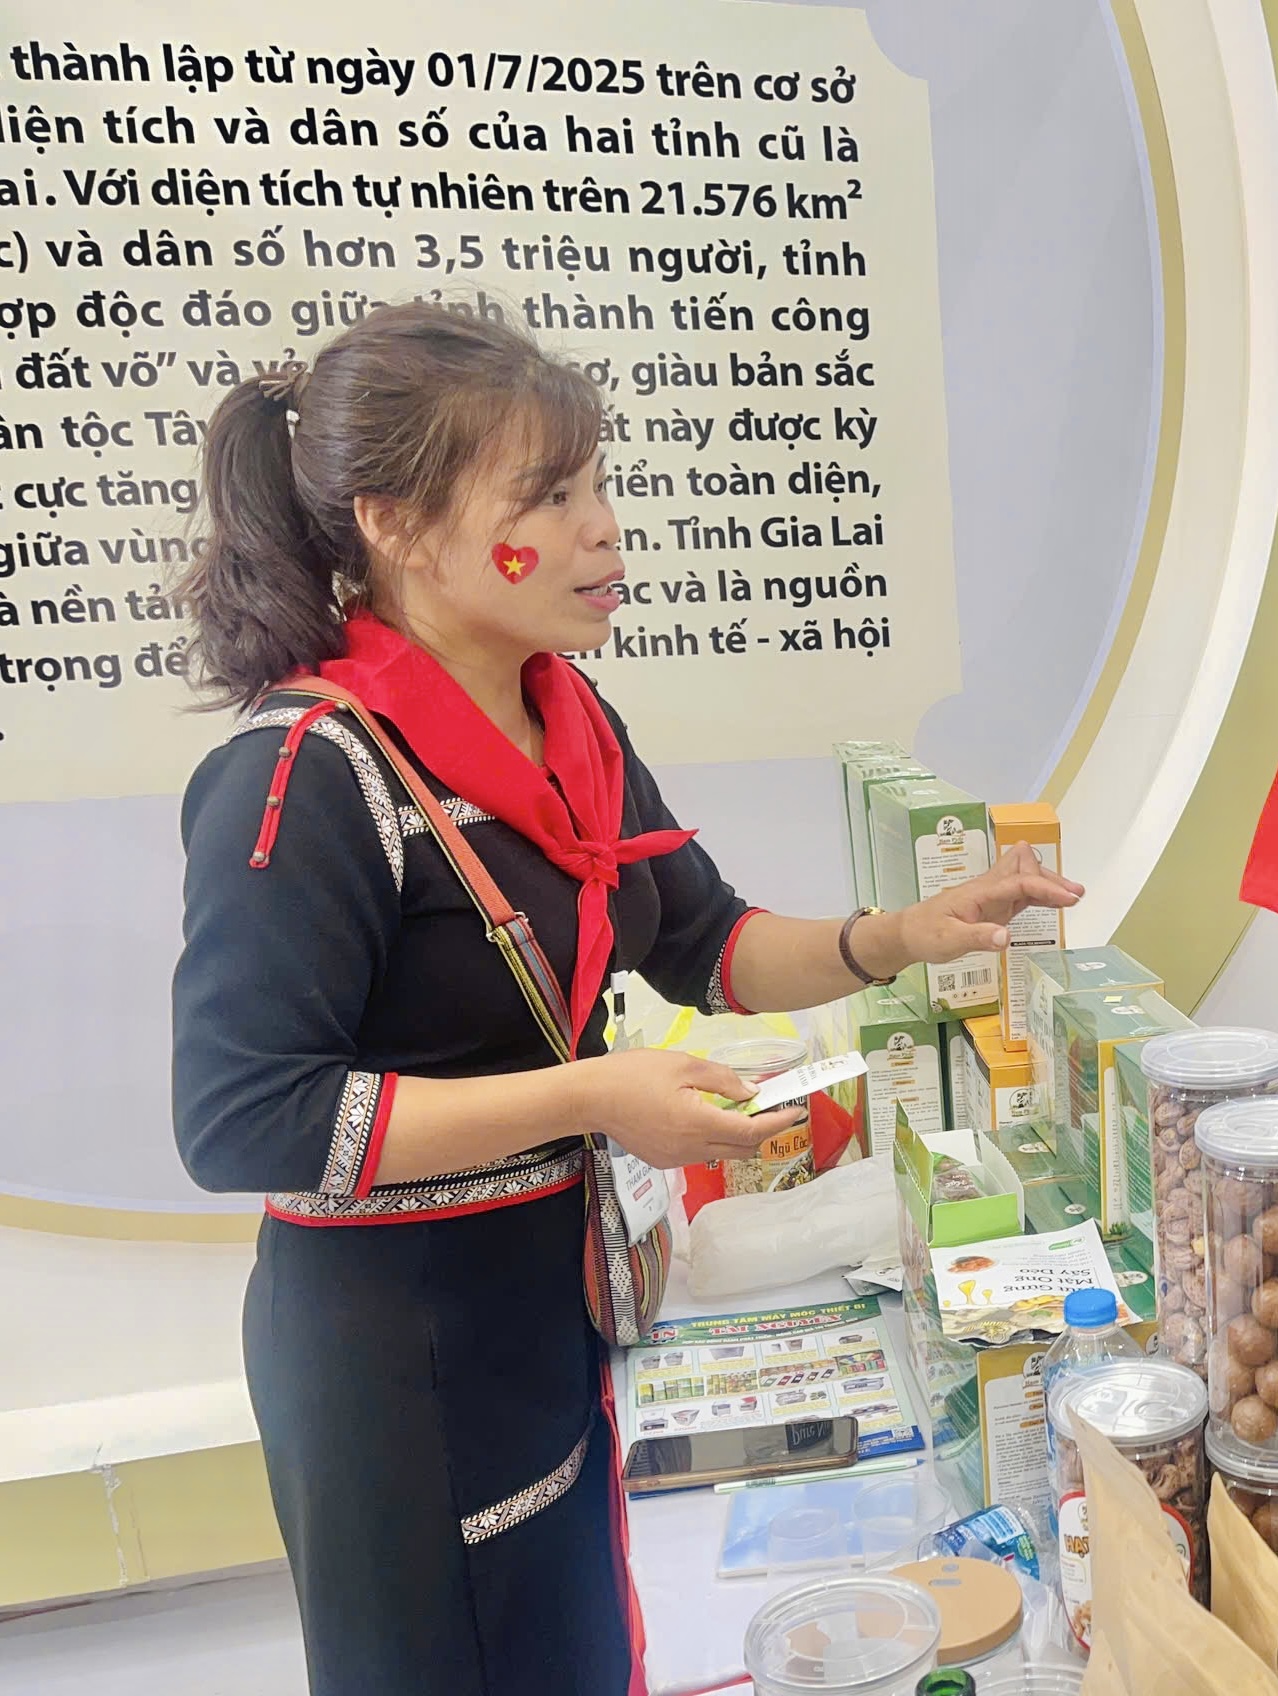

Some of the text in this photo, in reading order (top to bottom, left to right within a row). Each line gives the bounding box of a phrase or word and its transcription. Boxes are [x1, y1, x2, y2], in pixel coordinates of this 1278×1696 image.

[9, 41, 857, 104] thành lập từ ngày 01/7/2025 trên cơ sở
[0, 104, 859, 163] iện tích và dân số của hai tỉnh cũ là
[62, 167, 140, 206] Với
[151, 167, 248, 217] diện
[258, 168, 344, 207] tích
[352, 174, 402, 219] tự
[410, 171, 534, 211] nhiên
[542, 176, 630, 214] trên
[639, 180, 778, 218] 21.576
[785, 178, 863, 220] km²
[44, 229, 104, 268] và
[122, 228, 214, 267] dân
[233, 224, 285, 267] số
[303, 229, 396, 268] hơn
[414, 233, 484, 275] 3,5
[501, 233, 610, 284] triệu
[628, 238, 767, 283] người,
[782, 238, 867, 277] tỉnh
[76, 290, 165, 338] độc
[182, 289, 272, 327] đáo
[522, 292, 654, 330] thành
[670, 291, 754, 331] tiến
[771, 296, 870, 341] công
[15, 346, 92, 390] đất
[100, 351, 177, 388] võ”
[186, 349, 245, 391] và
[631, 352, 718, 396] giàu
[729, 350, 804, 387] bản
[814, 348, 875, 387] sắc
[60, 411, 134, 458] tộc
[645, 408, 715, 452] này
[728, 407, 822, 451] được
[833, 406, 878, 450] kỳ
[13, 476, 88, 519] cực
[96, 470, 199, 514] tăng
[686, 462, 776, 497] toàn
[787, 461, 881, 504] diện,
[667, 515, 752, 550] Tỉnh
[760, 515, 823, 548] Gia
[831, 513, 884, 547] Lai
[30, 583, 116, 625] nền
[659, 570, 707, 604] và
[717, 569, 752, 602] là
[763, 563, 888, 607] nguồn
[0, 653, 122, 692] trọng
[613, 623, 699, 659] kinh
[708, 617, 748, 655] tế
[778, 619, 823, 652] xã
[832, 616, 891, 658] hội
